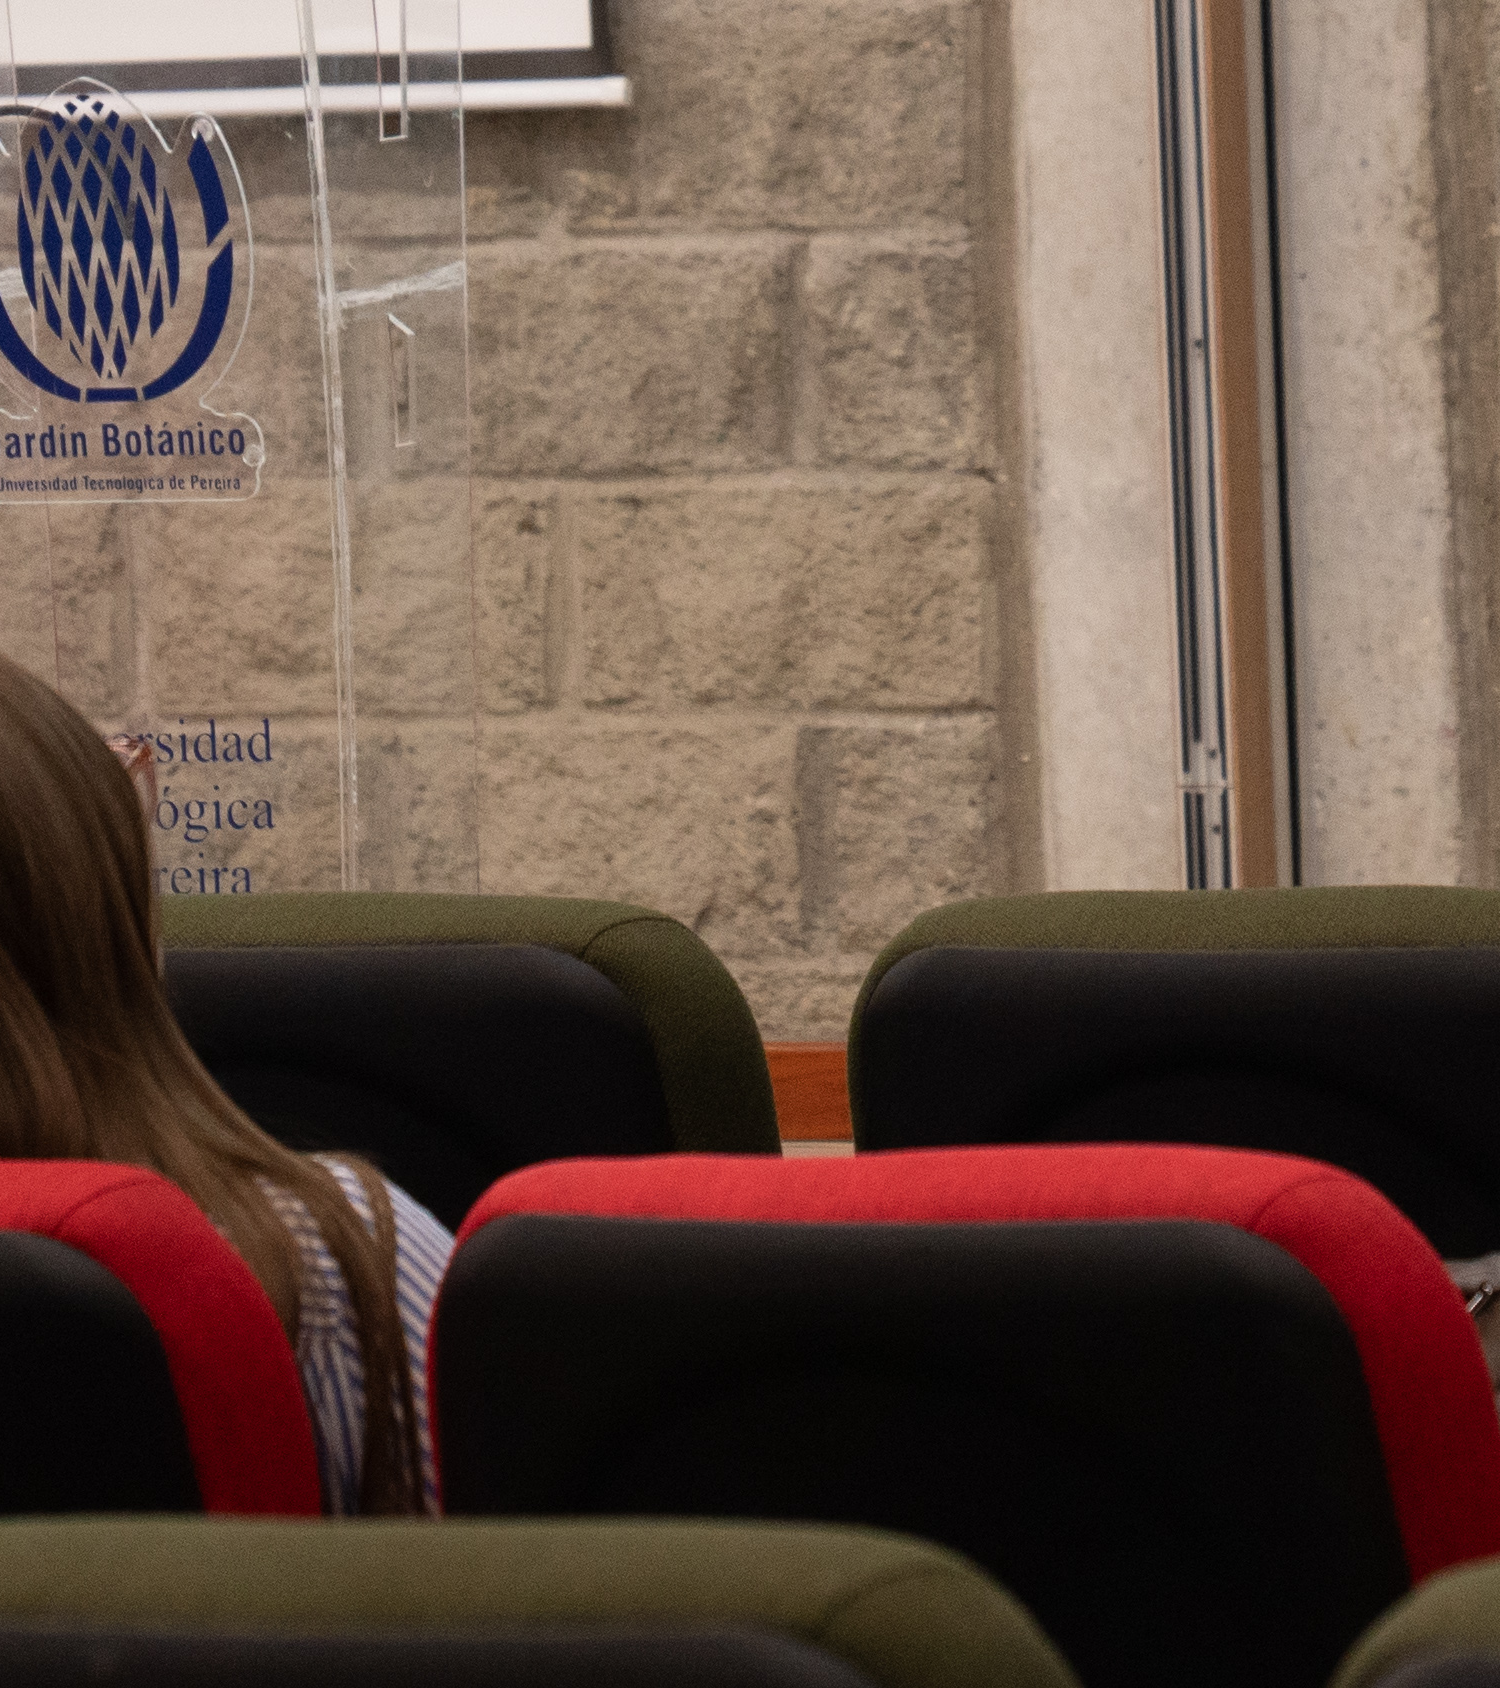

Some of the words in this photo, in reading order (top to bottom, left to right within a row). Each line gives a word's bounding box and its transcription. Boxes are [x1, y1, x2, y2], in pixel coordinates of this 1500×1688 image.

[102, 421, 245, 457] Botánico
[169, 475, 185, 490] de
[190, 474, 240, 490] Pereira
[153, 852, 251, 894] reira
